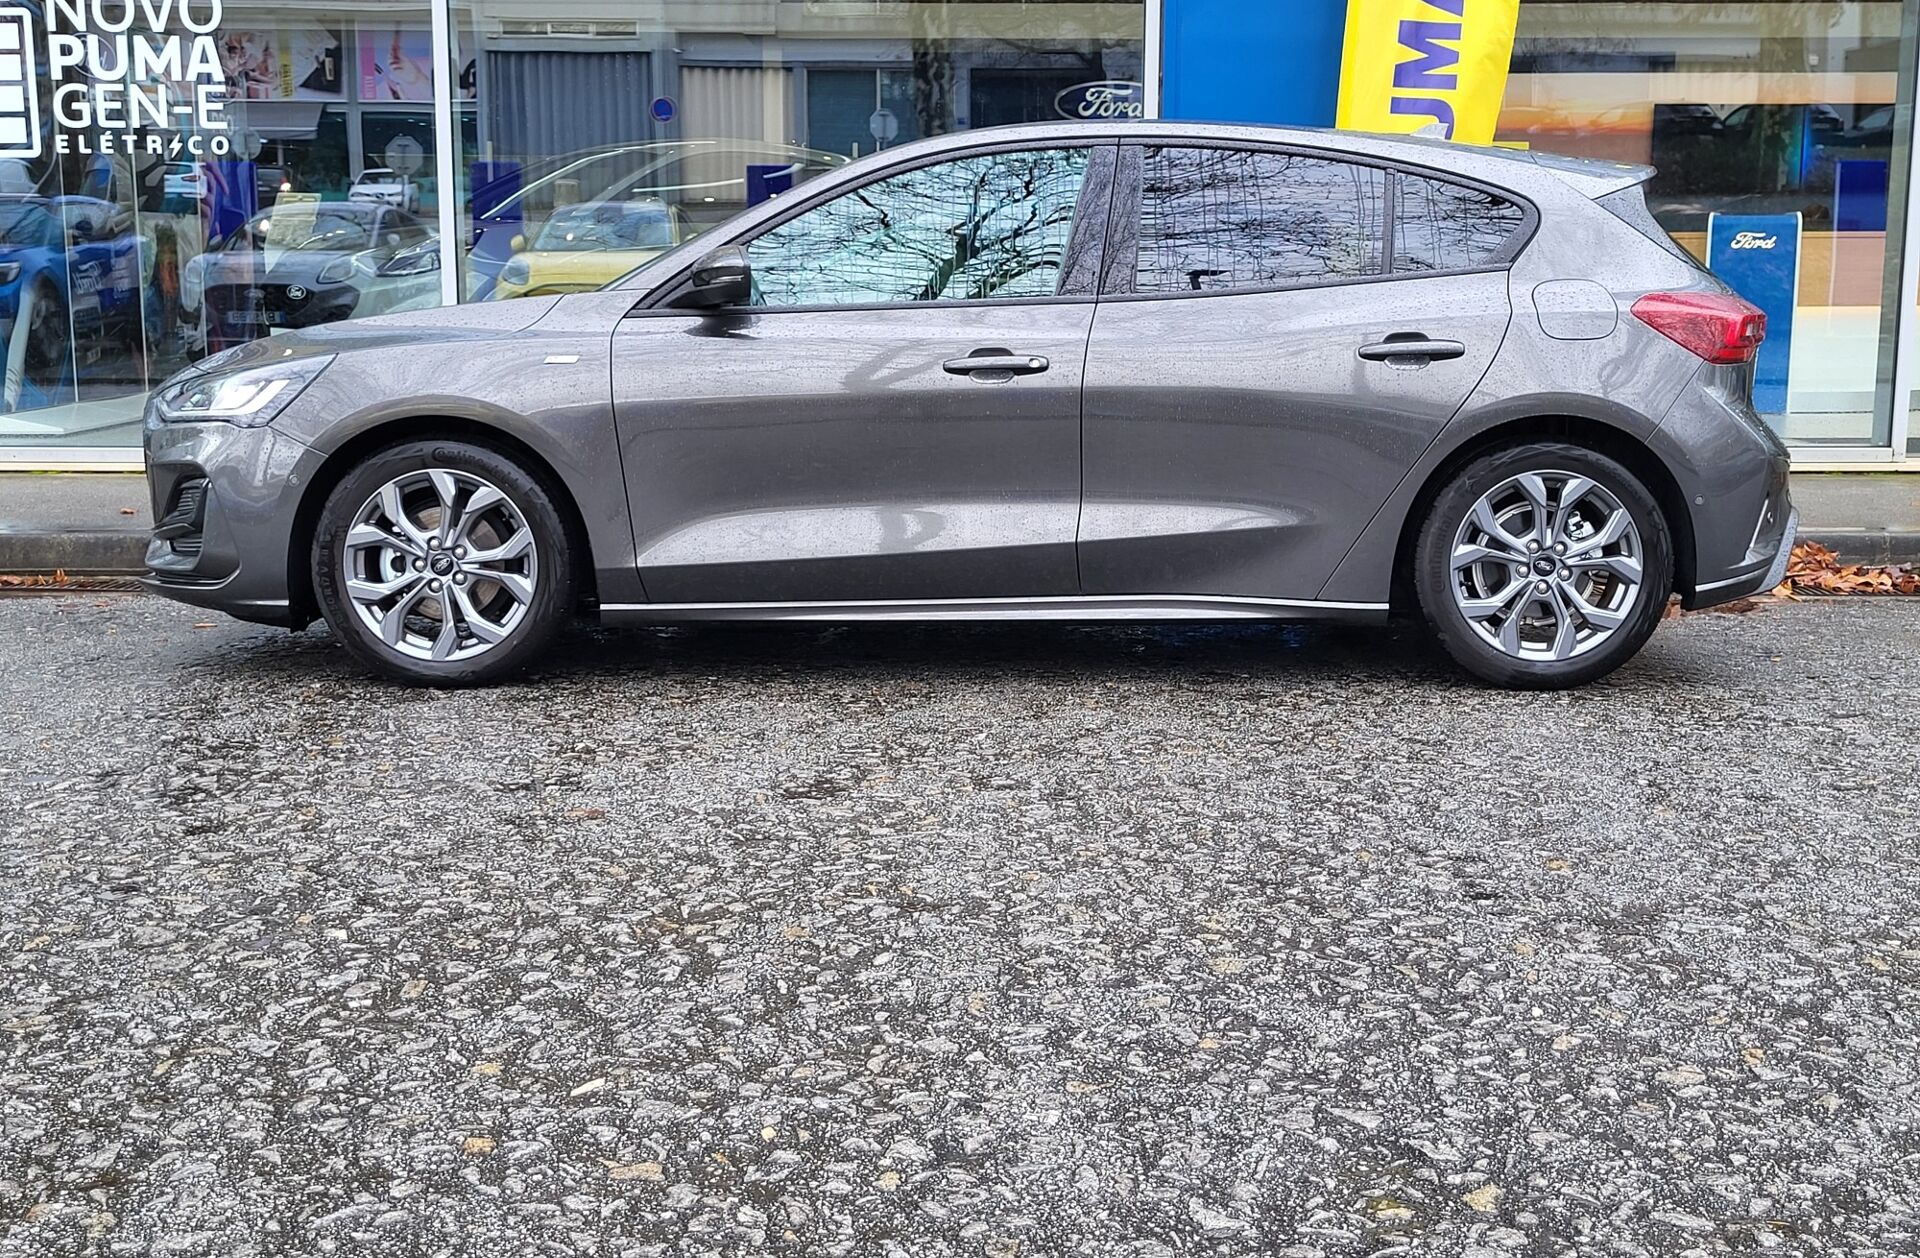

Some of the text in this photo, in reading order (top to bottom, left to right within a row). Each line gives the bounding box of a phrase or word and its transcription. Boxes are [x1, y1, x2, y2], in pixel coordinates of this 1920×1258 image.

[46, 0, 223, 33] NOVO
[48, 34, 225, 81] PUMA
[53, 83, 228, 130] GEN-E
[1730, 231, 1777, 249] Ford
